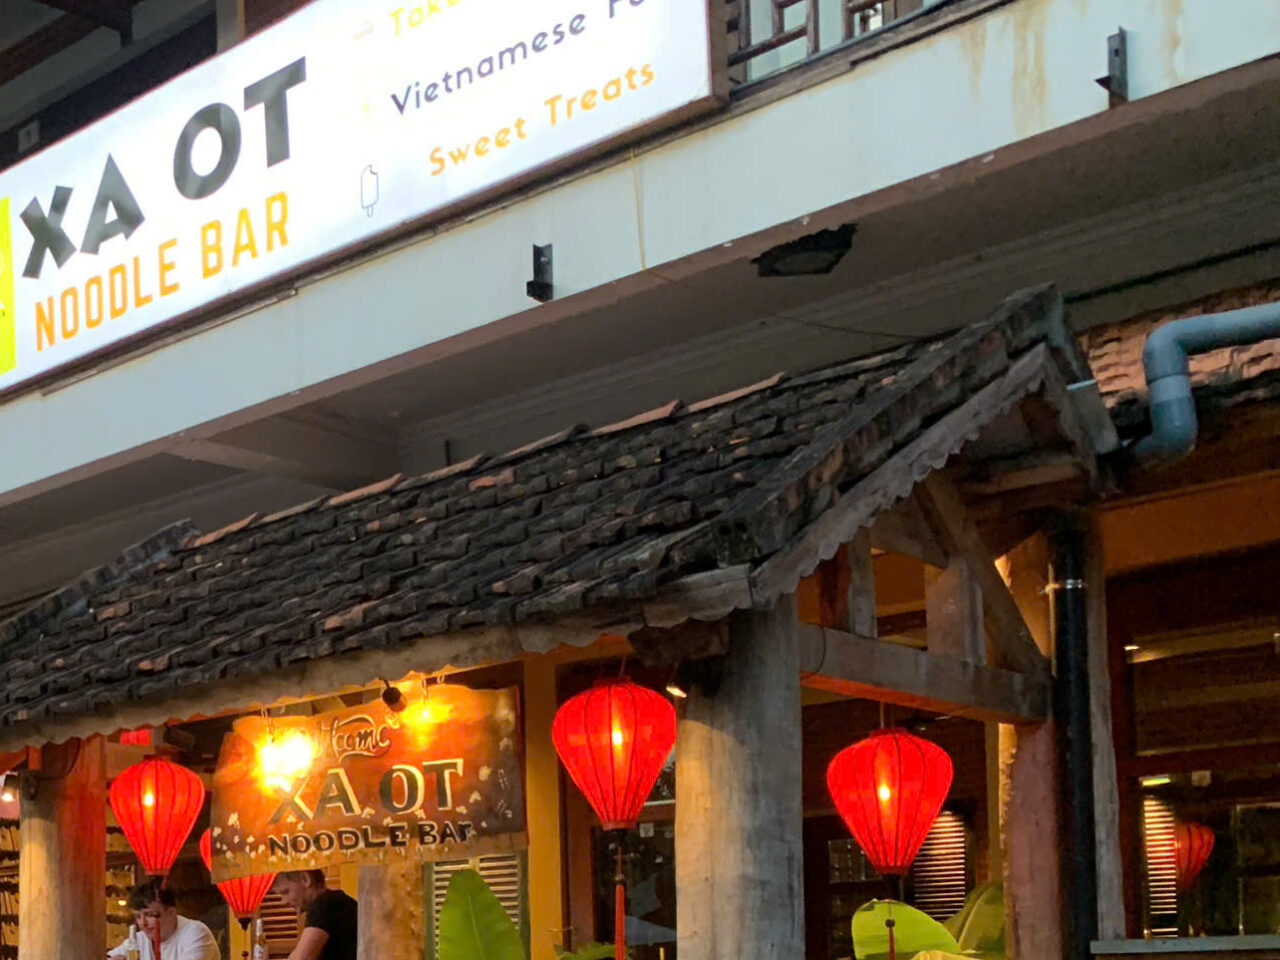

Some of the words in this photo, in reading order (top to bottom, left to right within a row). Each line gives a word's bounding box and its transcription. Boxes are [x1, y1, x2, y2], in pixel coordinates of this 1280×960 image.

[391, 13, 586, 116] Vietnamese
[20, 152, 146, 280] XA
[173, 56, 307, 200] OT
[429, 116, 527, 176] Sweet
[544, 63, 655, 127] Treats
[35, 238, 180, 352] NOODLE
[201, 191, 288, 280] BAR
[268, 824, 410, 856] NOODLE
[417, 820, 474, 847] BAR
[269, 767, 363, 824] XA
[378, 758, 465, 816] OT
